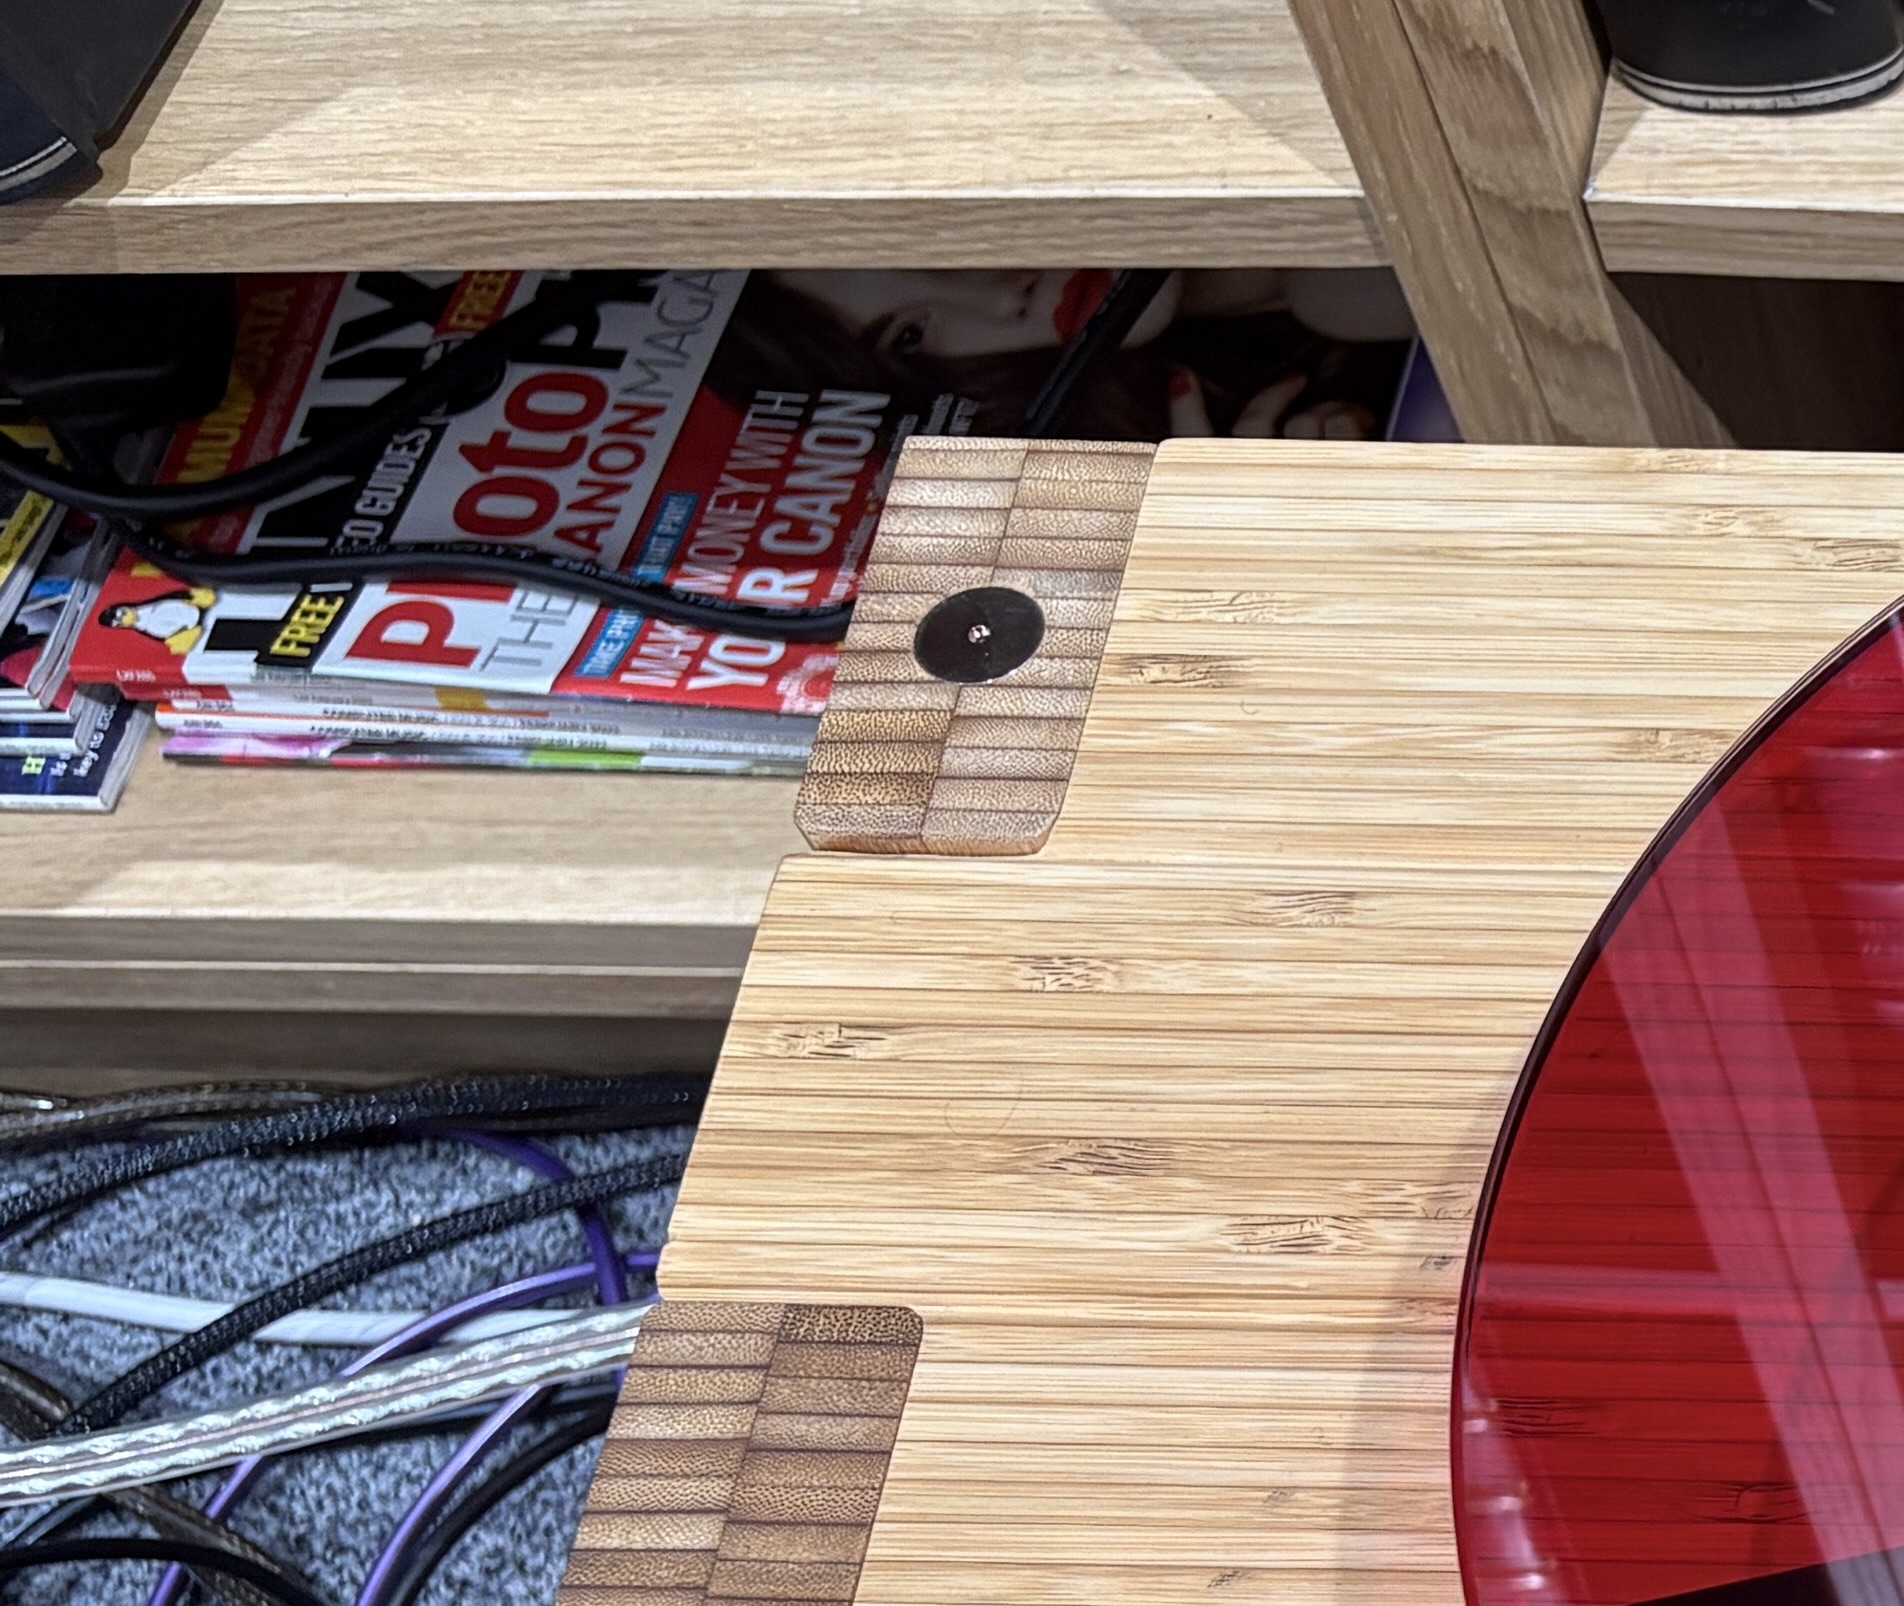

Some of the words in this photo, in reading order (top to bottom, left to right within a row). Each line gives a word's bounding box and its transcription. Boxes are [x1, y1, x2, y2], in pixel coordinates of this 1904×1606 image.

[272, 593, 347, 657] FREE
[358, 426, 435, 516] GUIDES
[481, 590, 581, 670] THE
[550, 402, 671, 558] ANON
[620, 619, 688, 687] MAK
[669, 474, 773, 594] MONEY
[726, 388, 808, 477] WITH
[688, 564, 818, 691] YOR
[757, 388, 892, 556] CANON
